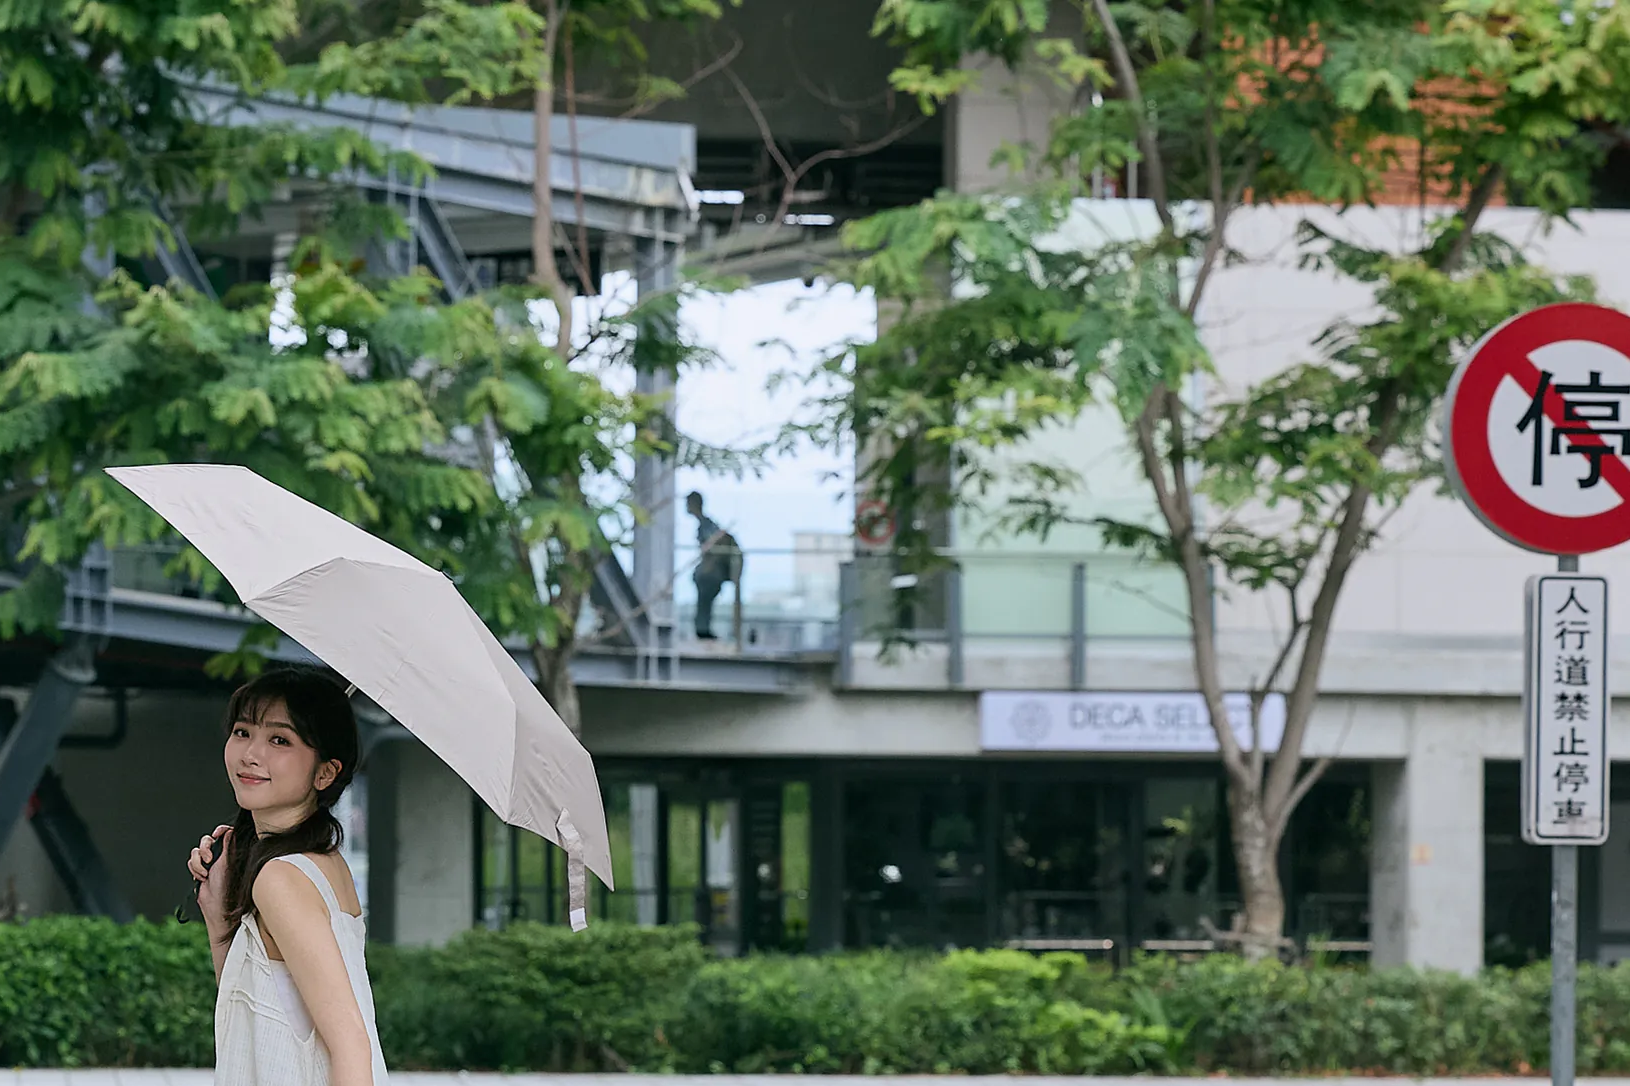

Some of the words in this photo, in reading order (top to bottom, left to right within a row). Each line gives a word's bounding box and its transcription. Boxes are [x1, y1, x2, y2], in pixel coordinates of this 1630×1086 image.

[1516, 369, 1630, 488] 停
[1068, 702, 1145, 729] DECA
[1553, 586, 1590, 824] 人行道禁止停車
